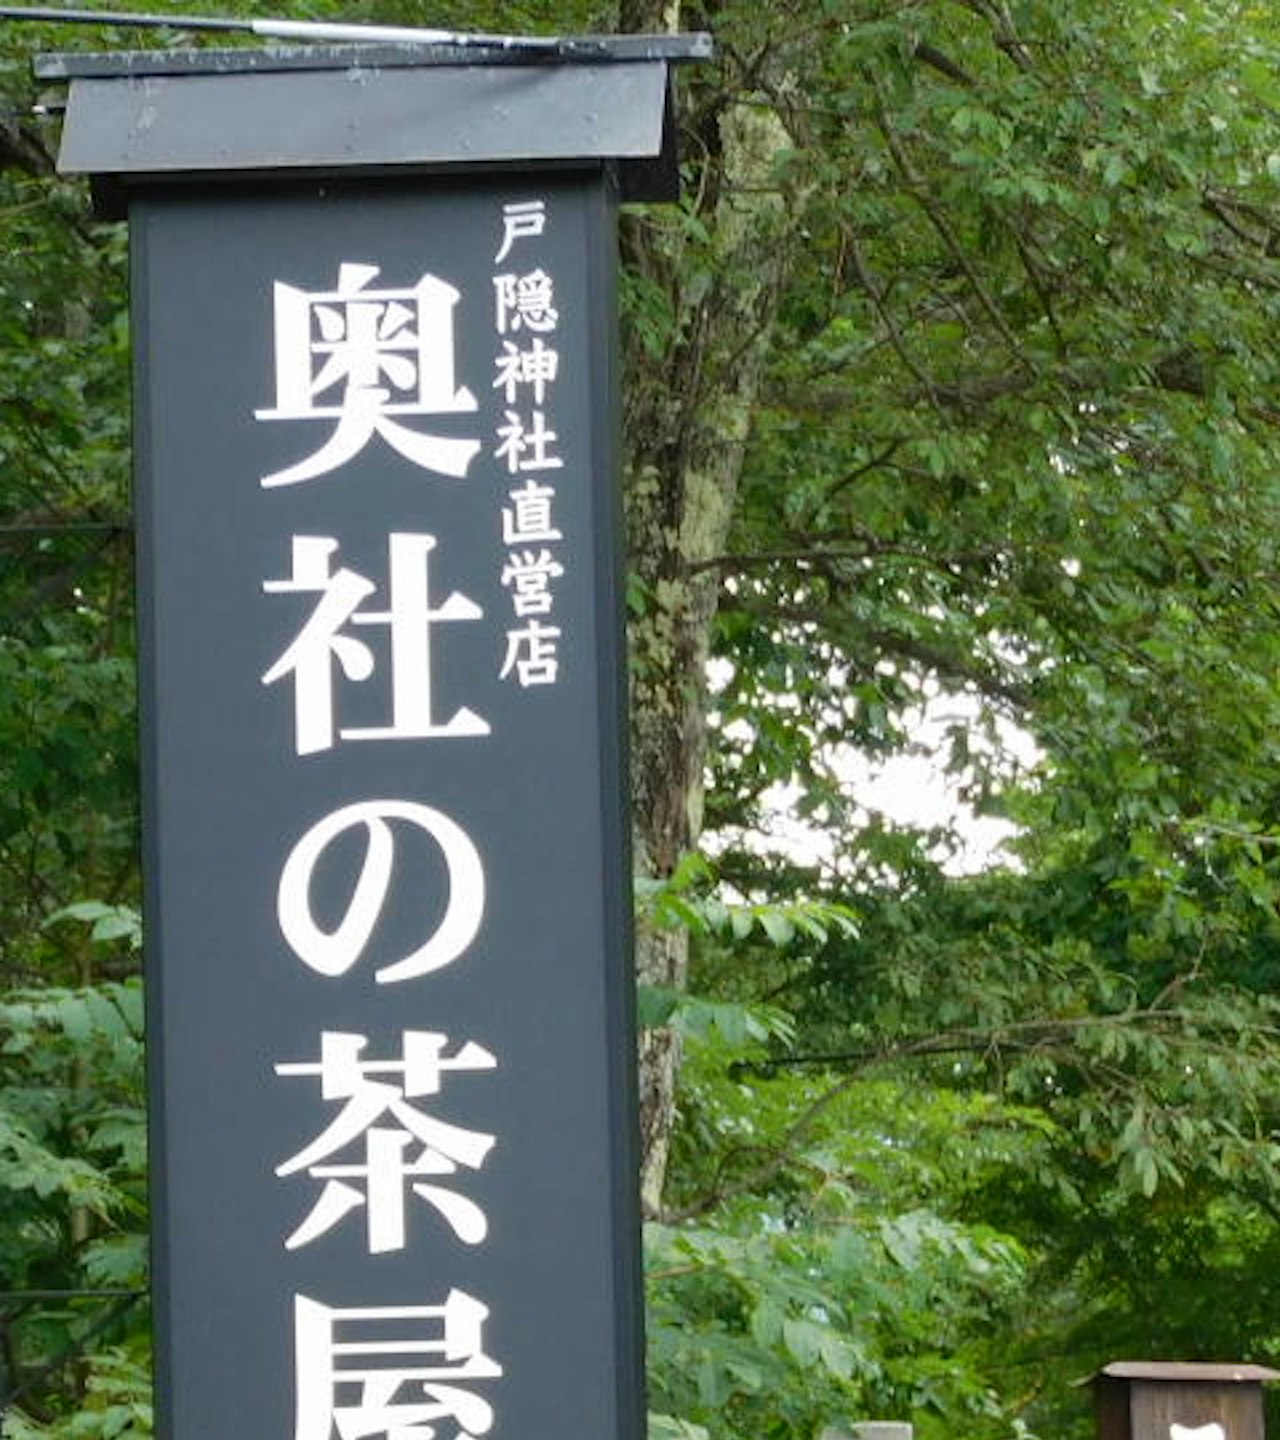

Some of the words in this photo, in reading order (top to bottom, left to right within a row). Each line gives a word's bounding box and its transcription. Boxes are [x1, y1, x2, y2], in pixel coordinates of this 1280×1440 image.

[491, 200, 566, 689] 戸隠神社直営店
